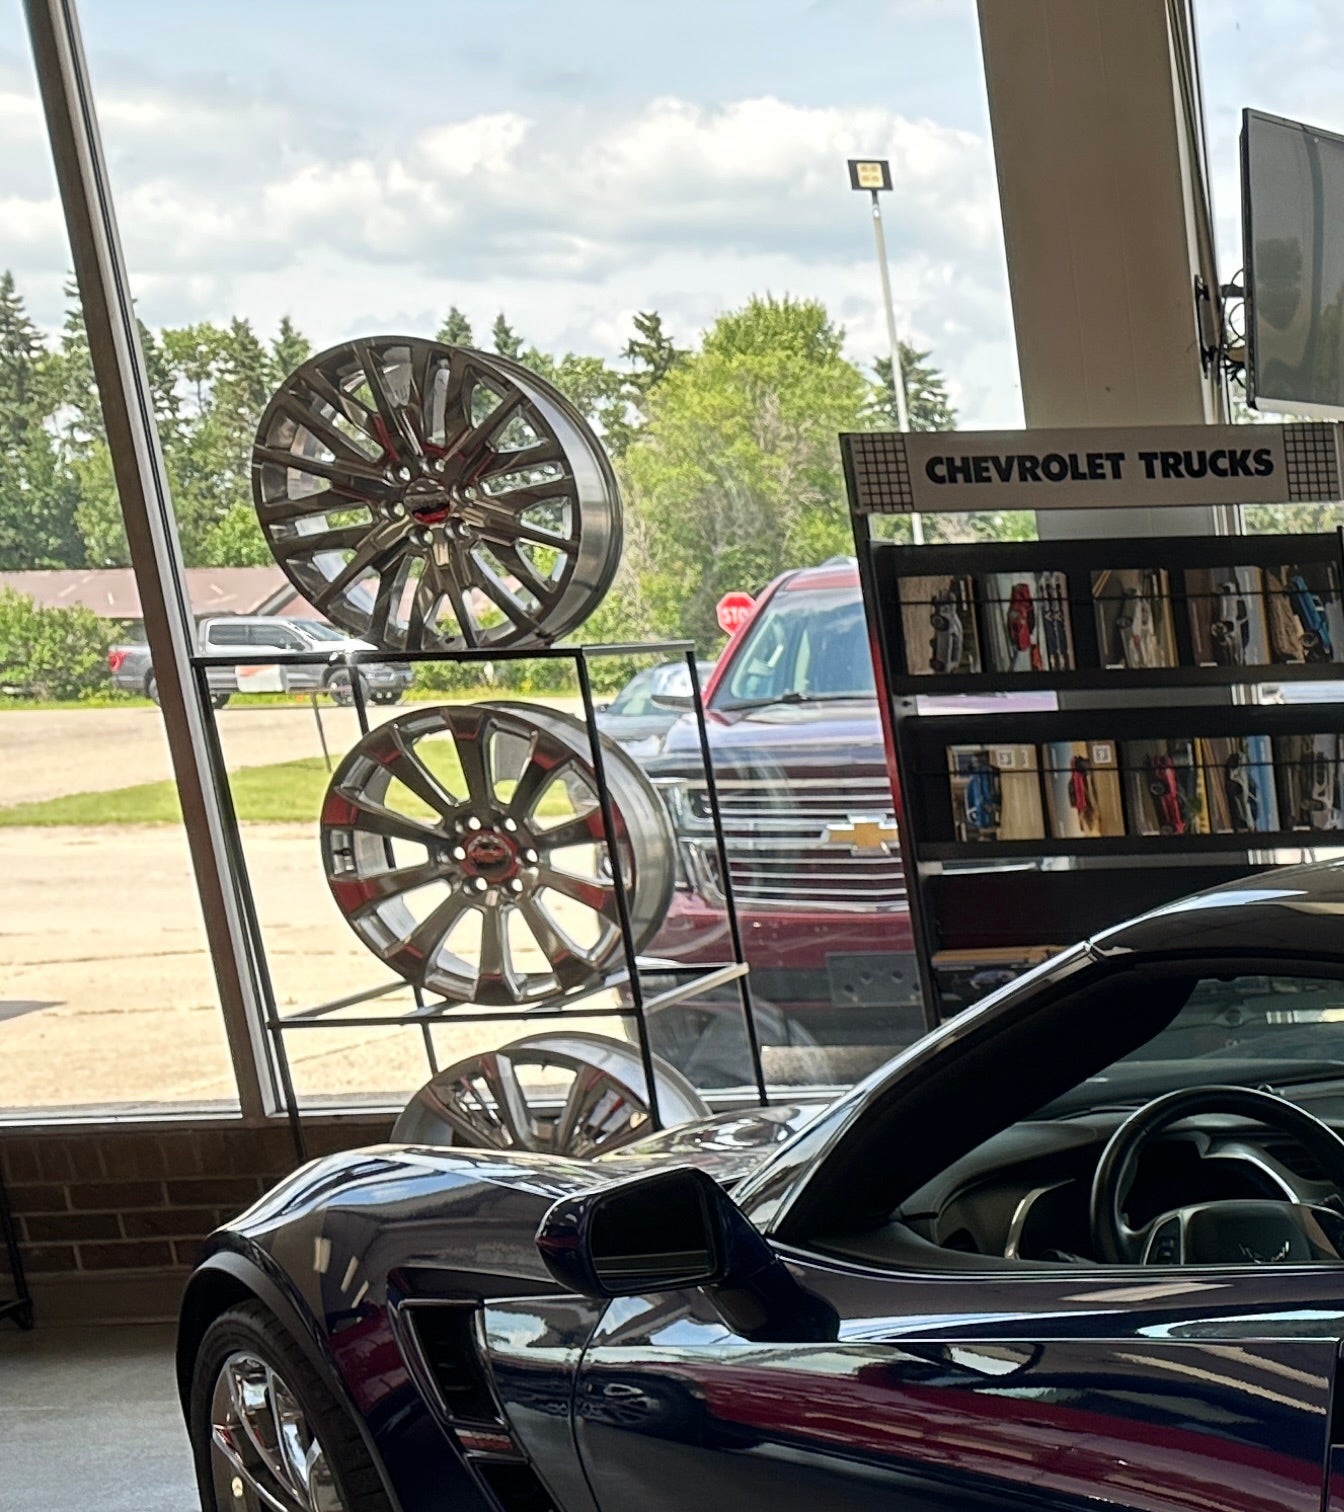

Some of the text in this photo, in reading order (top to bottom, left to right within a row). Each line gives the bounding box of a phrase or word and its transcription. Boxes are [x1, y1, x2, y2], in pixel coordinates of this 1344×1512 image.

[925, 448, 1274, 484] CHEVROLET TRUCKS
[722, 606, 749, 623] STO
